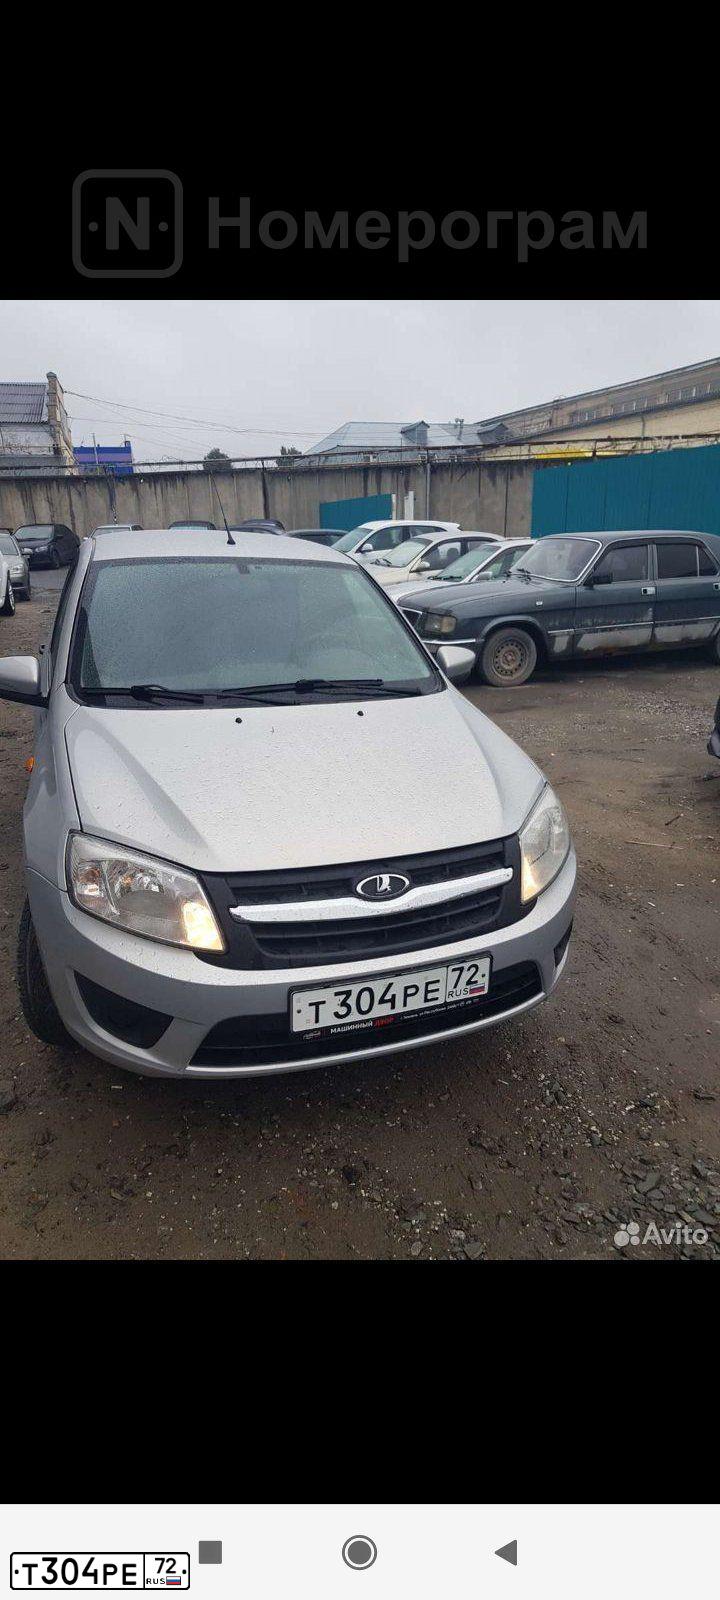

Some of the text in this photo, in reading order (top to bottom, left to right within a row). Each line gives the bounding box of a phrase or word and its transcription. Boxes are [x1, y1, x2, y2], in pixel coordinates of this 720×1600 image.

[308, 979, 440, 1024] Т304РЕ
[451, 963, 479, 990] 72
[447, 986, 469, 999] RUS
[330, 1020, 373, 1034] МАШИННЫЙ
